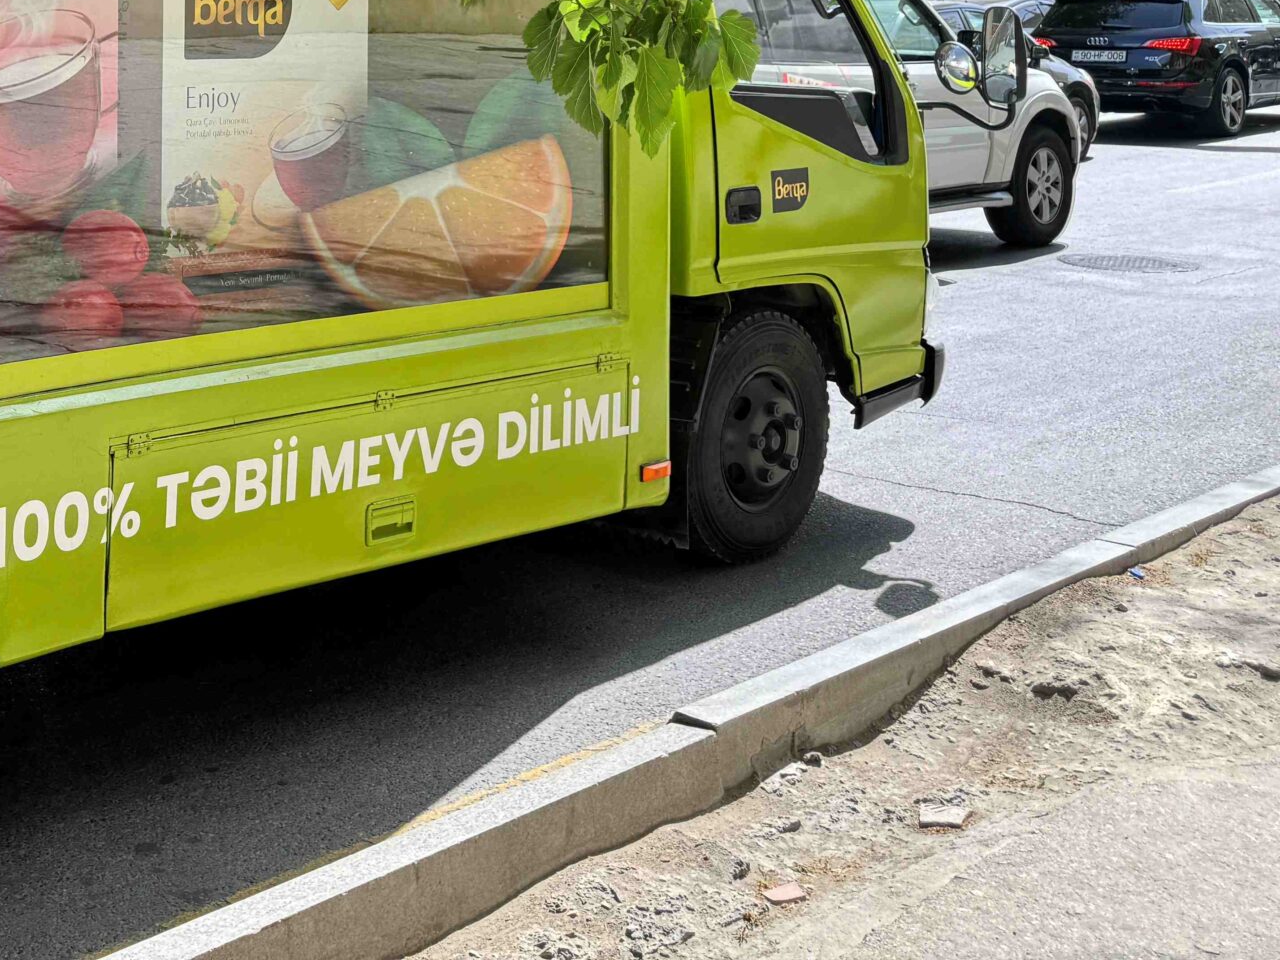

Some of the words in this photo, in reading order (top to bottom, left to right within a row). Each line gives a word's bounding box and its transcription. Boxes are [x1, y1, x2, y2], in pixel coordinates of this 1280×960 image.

[186, 86, 241, 114] Enjoy
[775, 176, 807, 203] Berqa
[156, 435, 299, 529] TƏBİİ
[310, 417, 485, 497] MEYVƏ
[497, 375, 641, 461] DİLİMLİ
